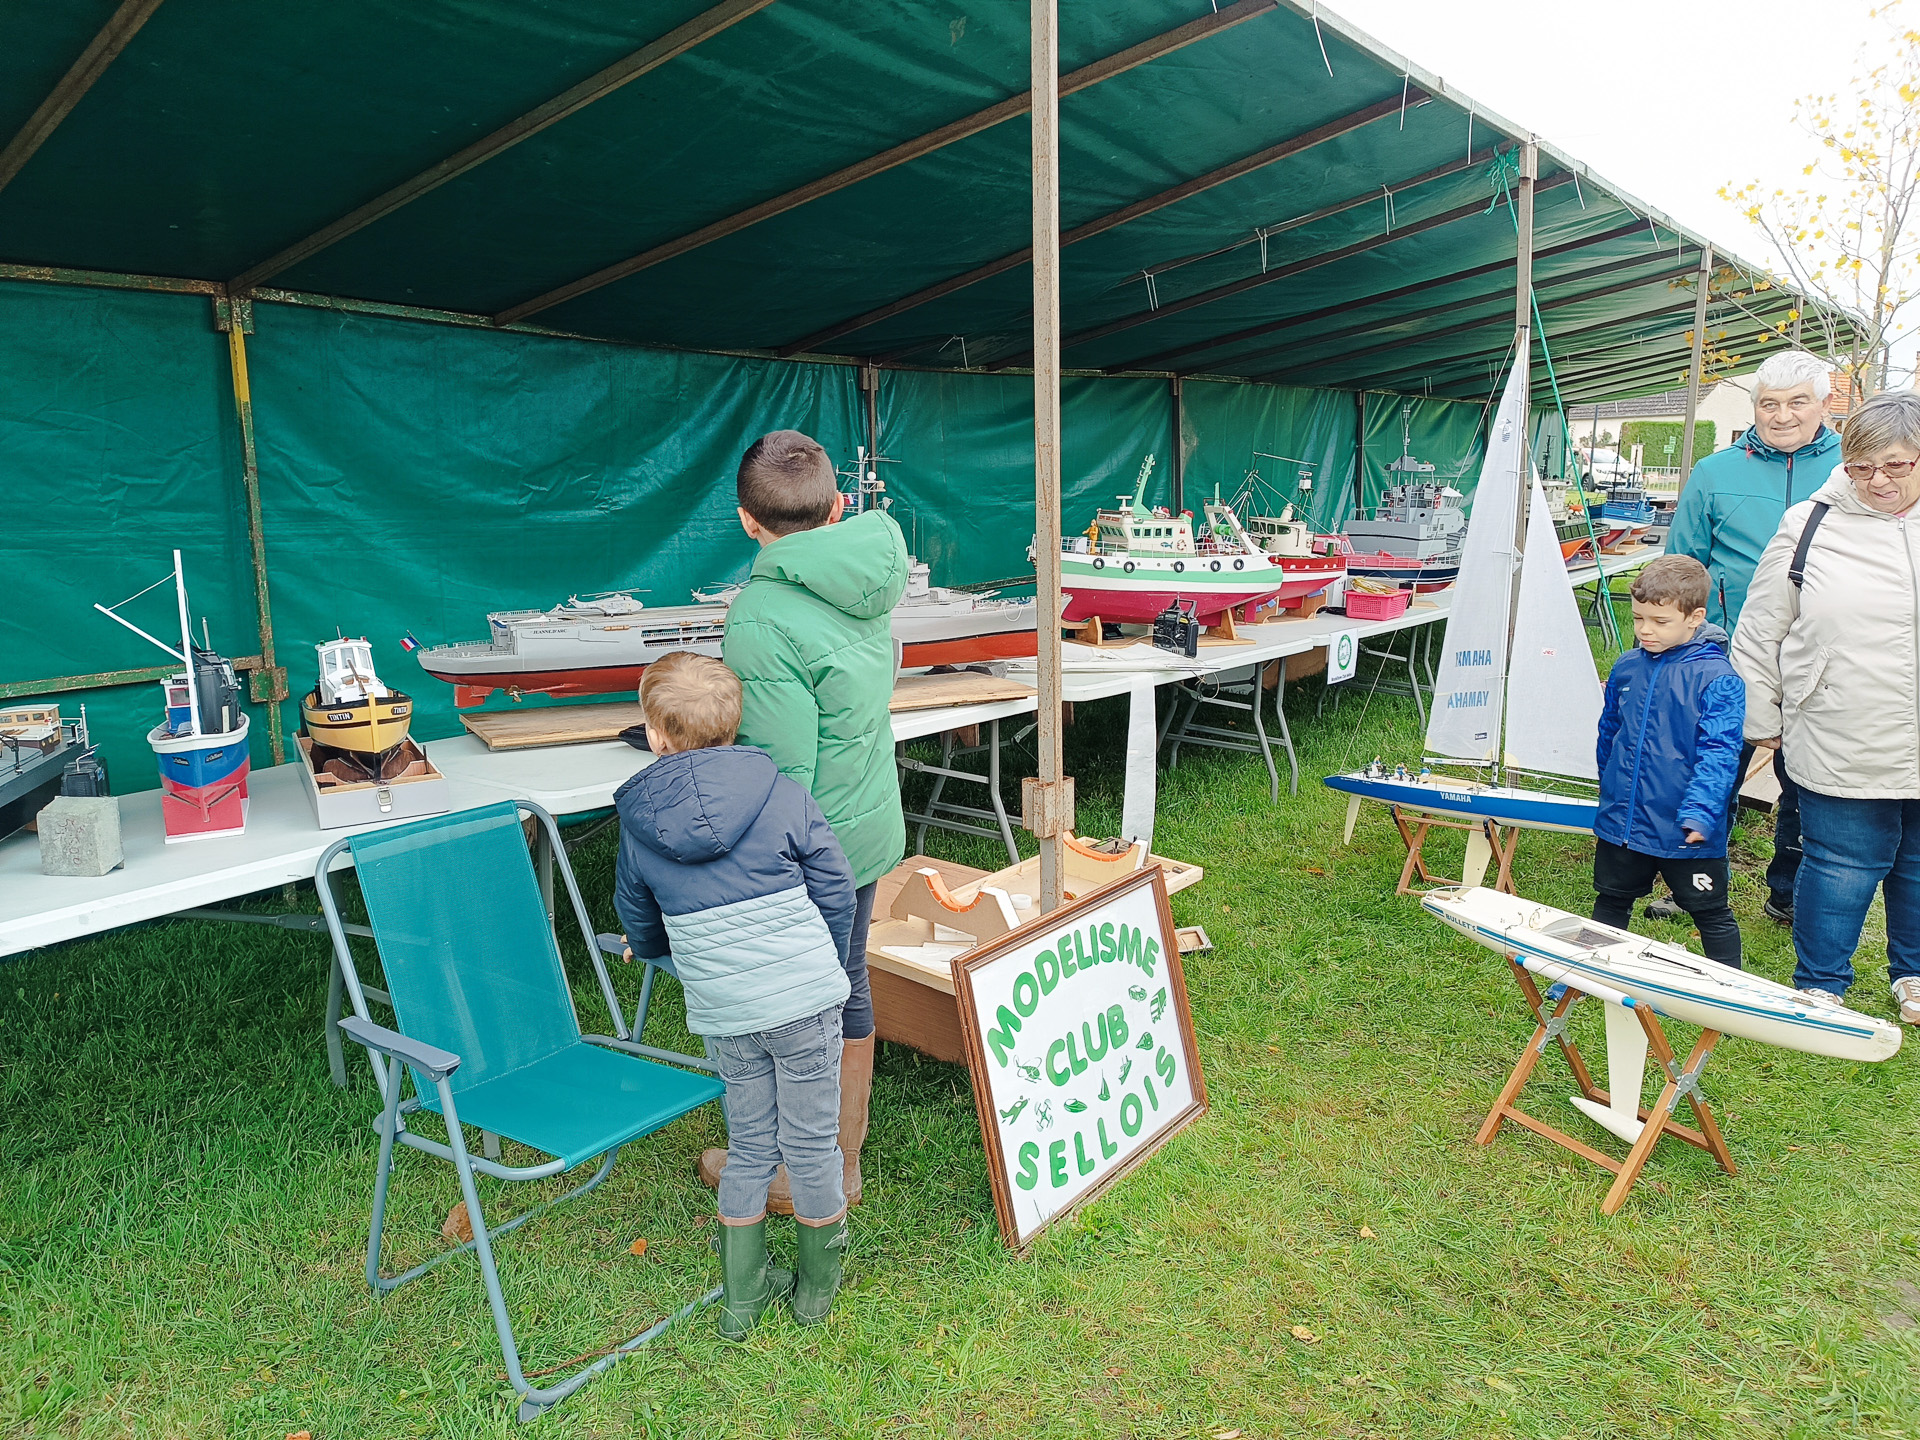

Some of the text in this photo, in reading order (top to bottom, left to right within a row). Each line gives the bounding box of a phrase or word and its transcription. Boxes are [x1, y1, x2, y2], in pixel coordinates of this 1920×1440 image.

[328, 712, 351, 721] TINTIN
[1440, 791, 1472, 804] YAMAHA
[1445, 913, 1476, 932] BULLET'S
[987, 922, 1160, 1068] MODELISME
[1045, 1003, 1129, 1087] CLUB
[1015, 1045, 1176, 1191] SELLOIS
